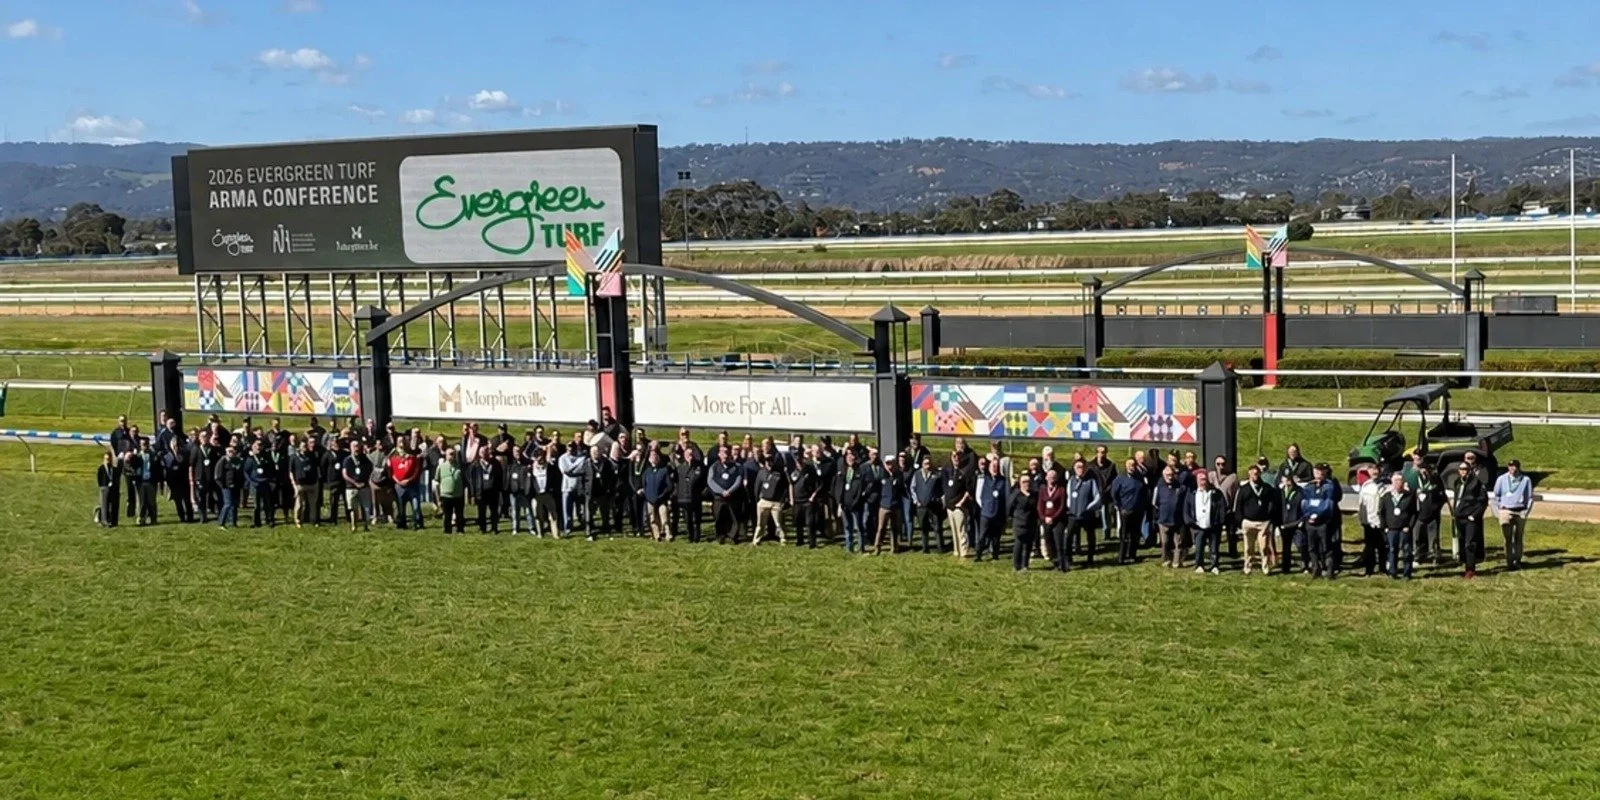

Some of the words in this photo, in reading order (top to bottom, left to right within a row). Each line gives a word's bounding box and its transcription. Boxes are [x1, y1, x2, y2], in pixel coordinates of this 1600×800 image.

[208, 168, 244, 186] 2026
[247, 164, 334, 184] EVERGREEN
[338, 161, 377, 180] TURF
[209, 188, 259, 209] ARMA
[262, 184, 379, 207] CONFERENCE
[415, 174, 606, 255] Evergreen
[540, 222, 605, 249] TURF
[465, 389, 548, 412] Morphettville
[691, 394, 736, 415] More
[739, 395, 766, 415] For
[769, 396, 807, 416] All...
